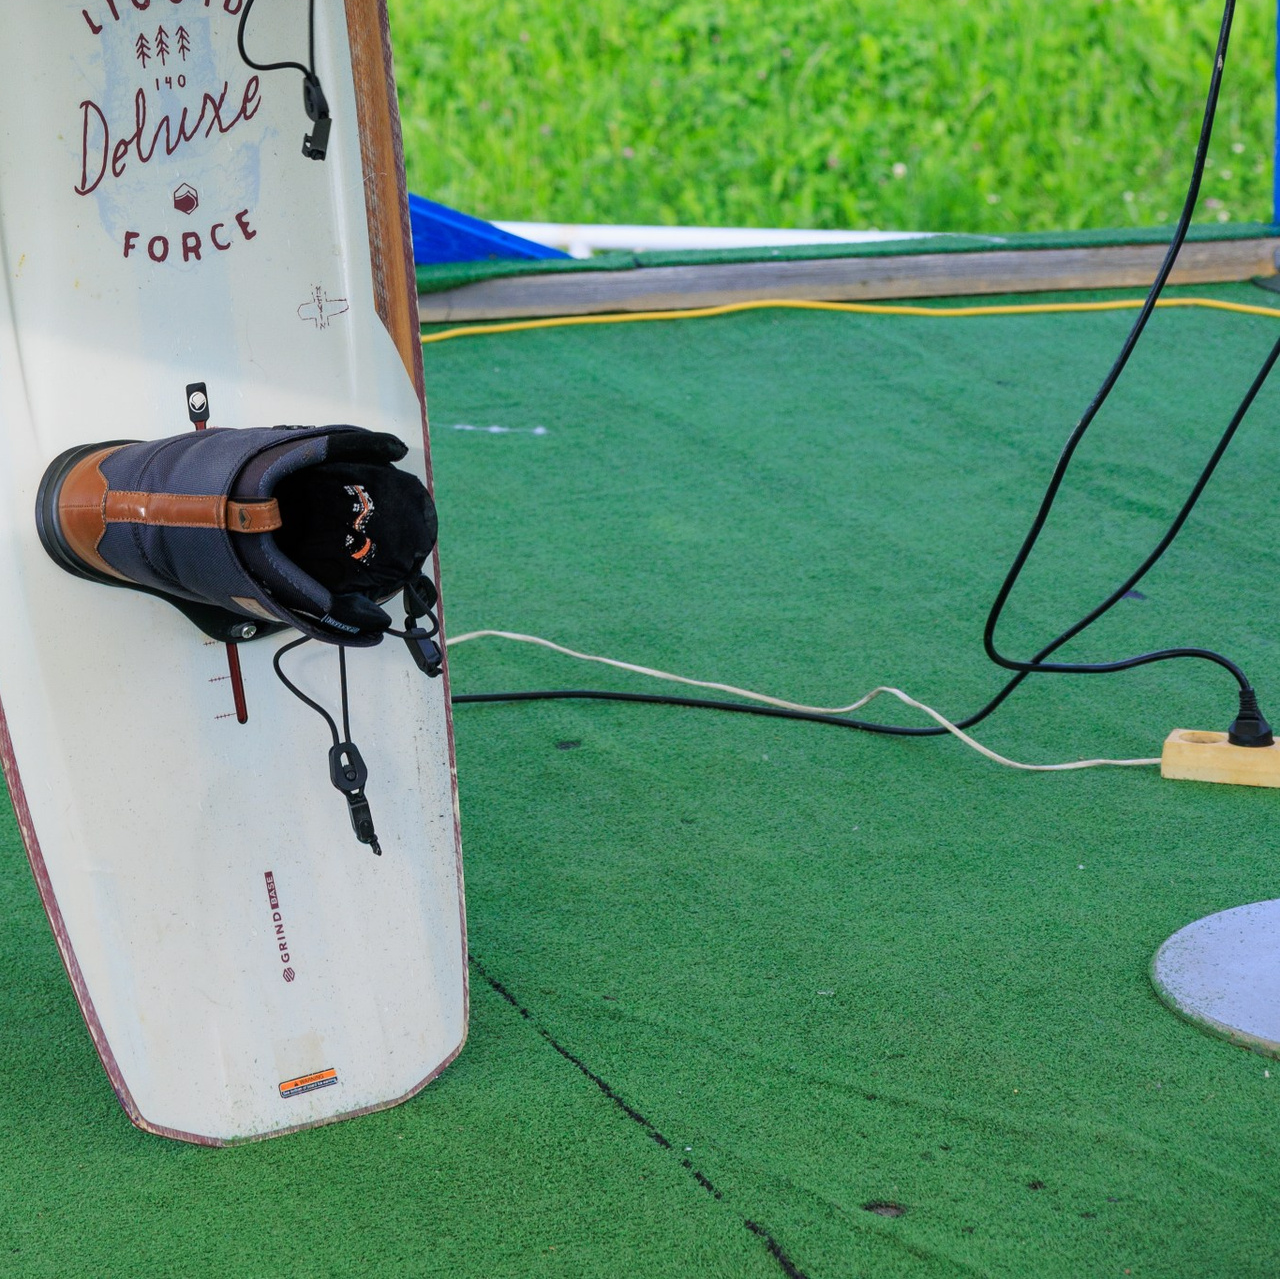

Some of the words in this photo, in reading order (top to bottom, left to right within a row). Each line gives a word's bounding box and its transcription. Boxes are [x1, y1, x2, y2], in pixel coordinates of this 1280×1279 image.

[155, 74, 186, 91] 140
[74, 75, 262, 196] Deluxe
[123, 209, 257, 263] FORCE
[266, 875, 278, 905] BASE
[272, 911, 290, 963] GRIND
